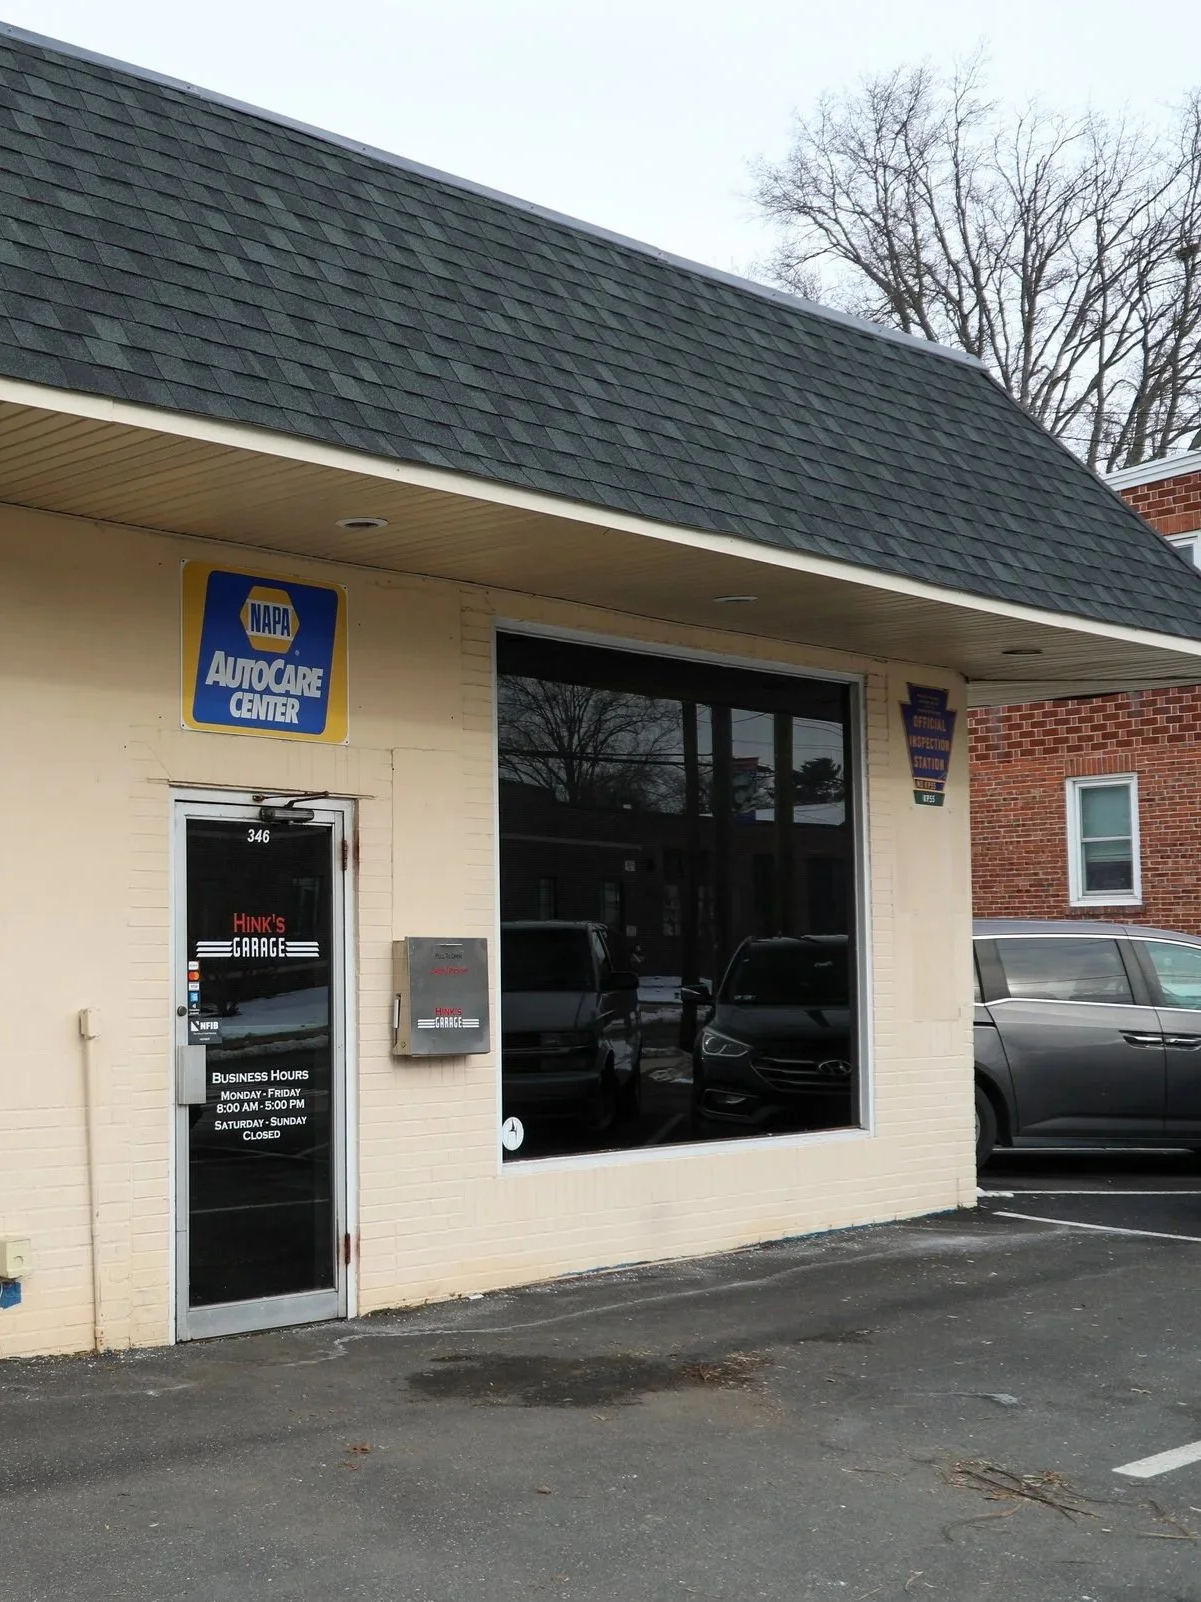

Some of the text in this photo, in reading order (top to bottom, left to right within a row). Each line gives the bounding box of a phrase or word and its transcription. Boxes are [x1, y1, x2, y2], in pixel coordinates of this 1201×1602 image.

[250, 602, 291, 637] NAPA
[229, 691, 300, 724] CENTER
[913, 715, 946, 732] OFFICIAL
[909, 735, 950, 753] INSPECTION
[913, 755, 945, 771] STATION
[247, 828, 271, 844] 346
[232, 937, 286, 958] GARAGE
[200, 1021, 219, 1030] NFIB
[435, 1016, 462, 1029] GARAGE
[216, 1102, 240, 1114] 8:00
[242, 1102, 259, 1112] AM
[265, 1100, 288, 1110] 5:00
[289, 1099, 305, 1109] PM
